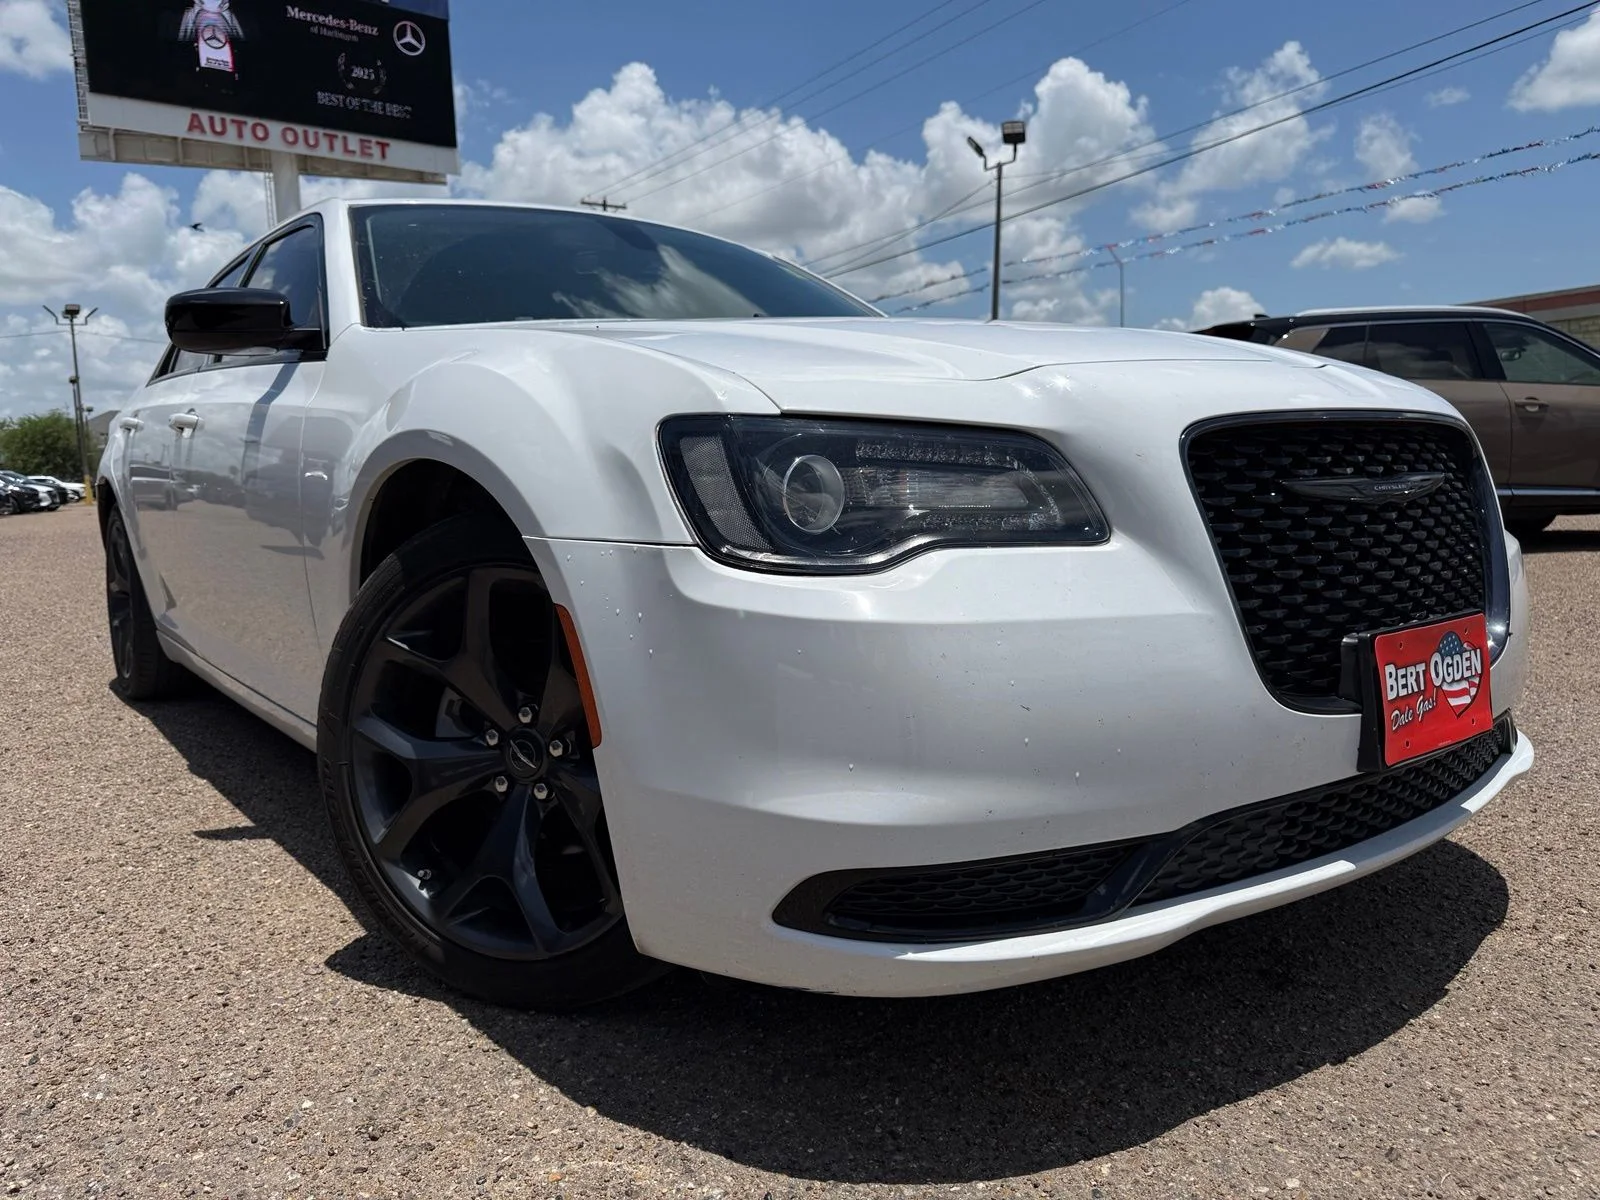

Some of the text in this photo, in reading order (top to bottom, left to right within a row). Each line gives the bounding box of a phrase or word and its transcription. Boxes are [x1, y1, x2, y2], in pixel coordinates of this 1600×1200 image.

[286, 5, 379, 36] Mercedes-Benz
[351, 65, 375, 80] 2025
[317, 91, 345, 107] BEST
[345, 96, 360, 110] OF
[187, 112, 391, 160] AUTO OUTLET
[1384, 648, 1482, 700] BERT OGDEN
[1391, 688, 1437, 731] Dale Gas!
